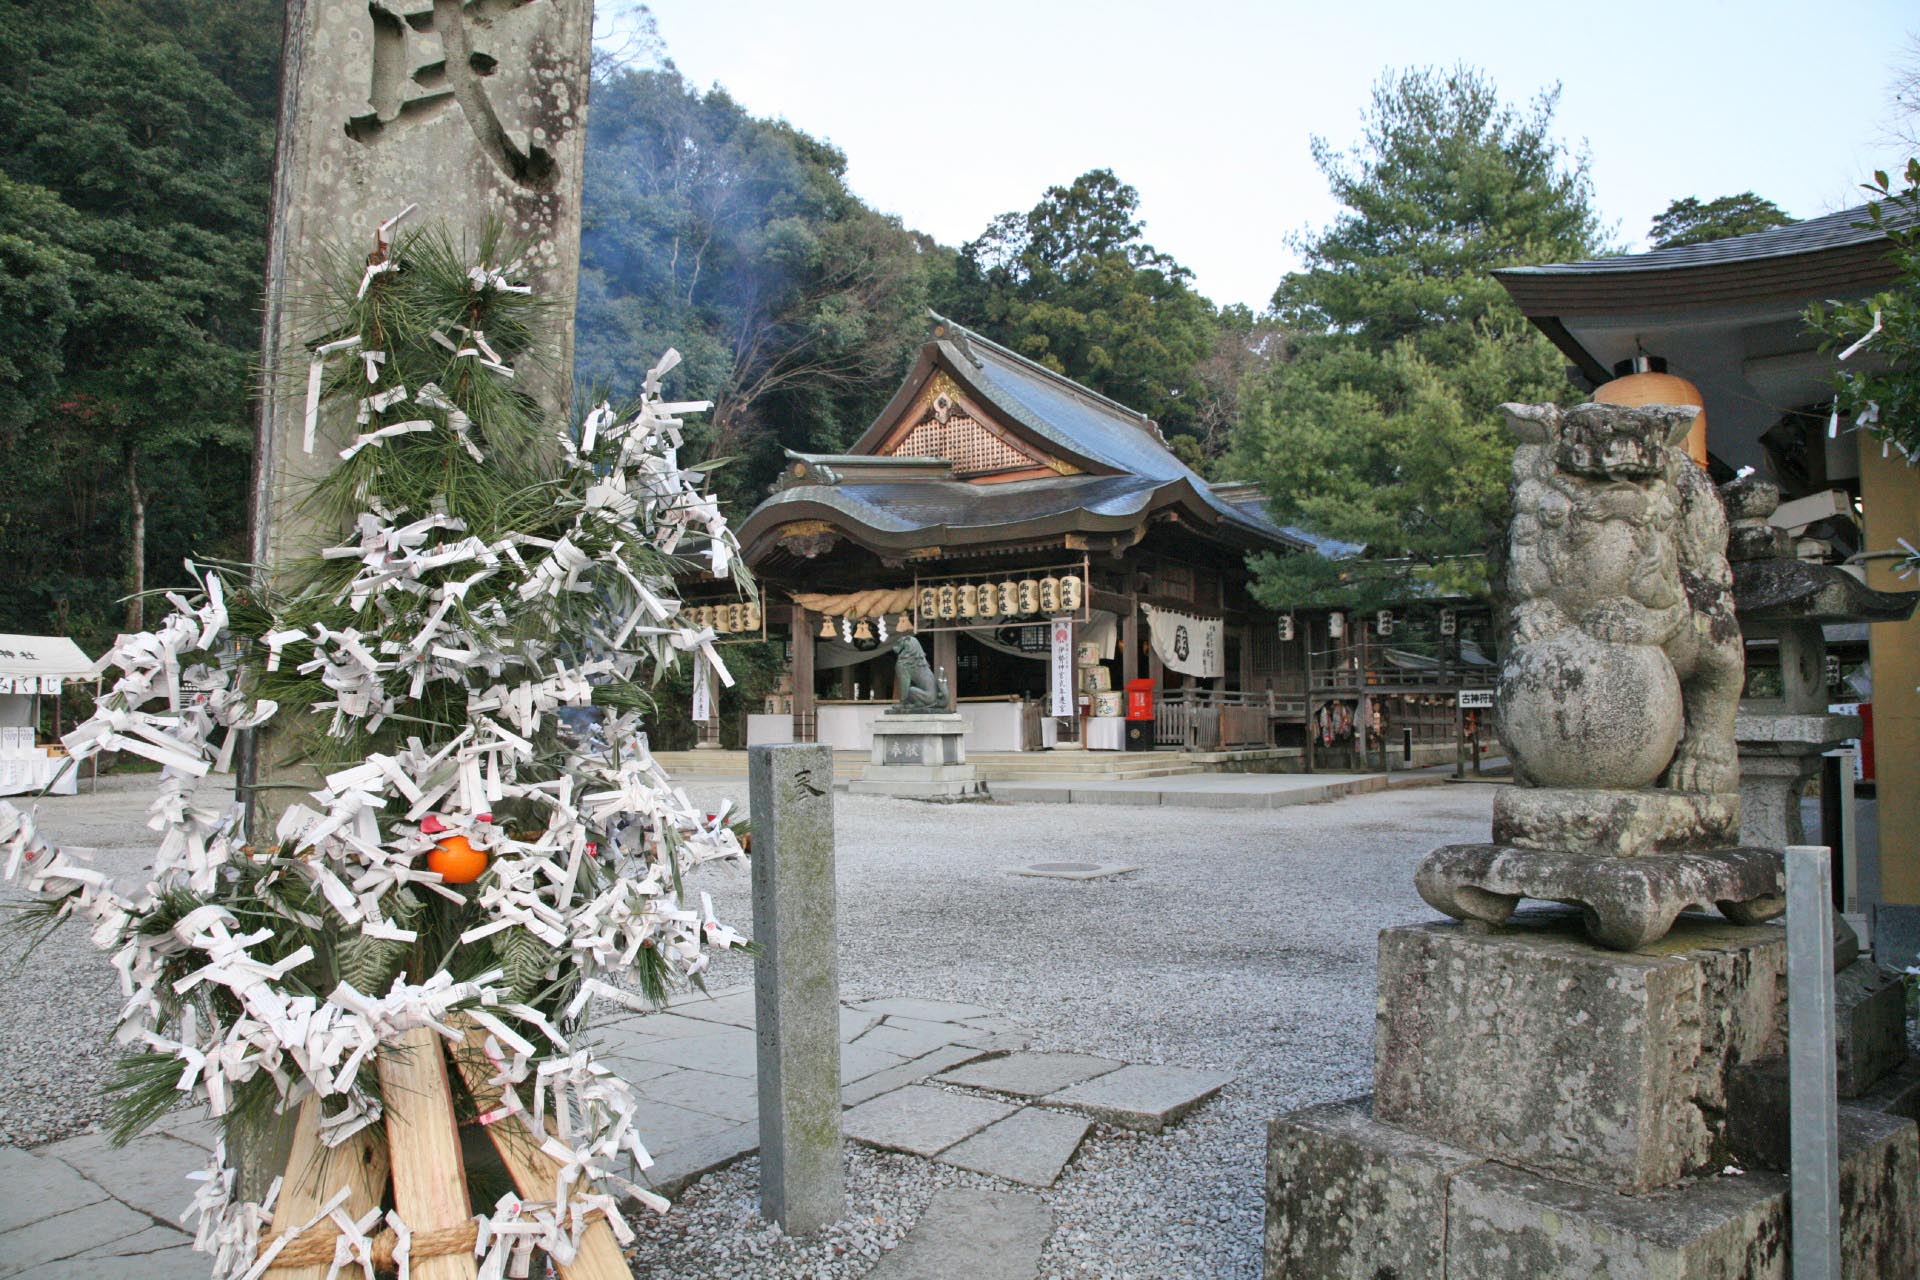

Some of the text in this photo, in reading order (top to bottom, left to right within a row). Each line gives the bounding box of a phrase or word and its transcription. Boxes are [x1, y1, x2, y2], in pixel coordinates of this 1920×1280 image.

[923, 590, 934, 616] 御神燈
[942, 587, 953, 615] 御神燈
[1019, 582, 1030, 611] 御神燈
